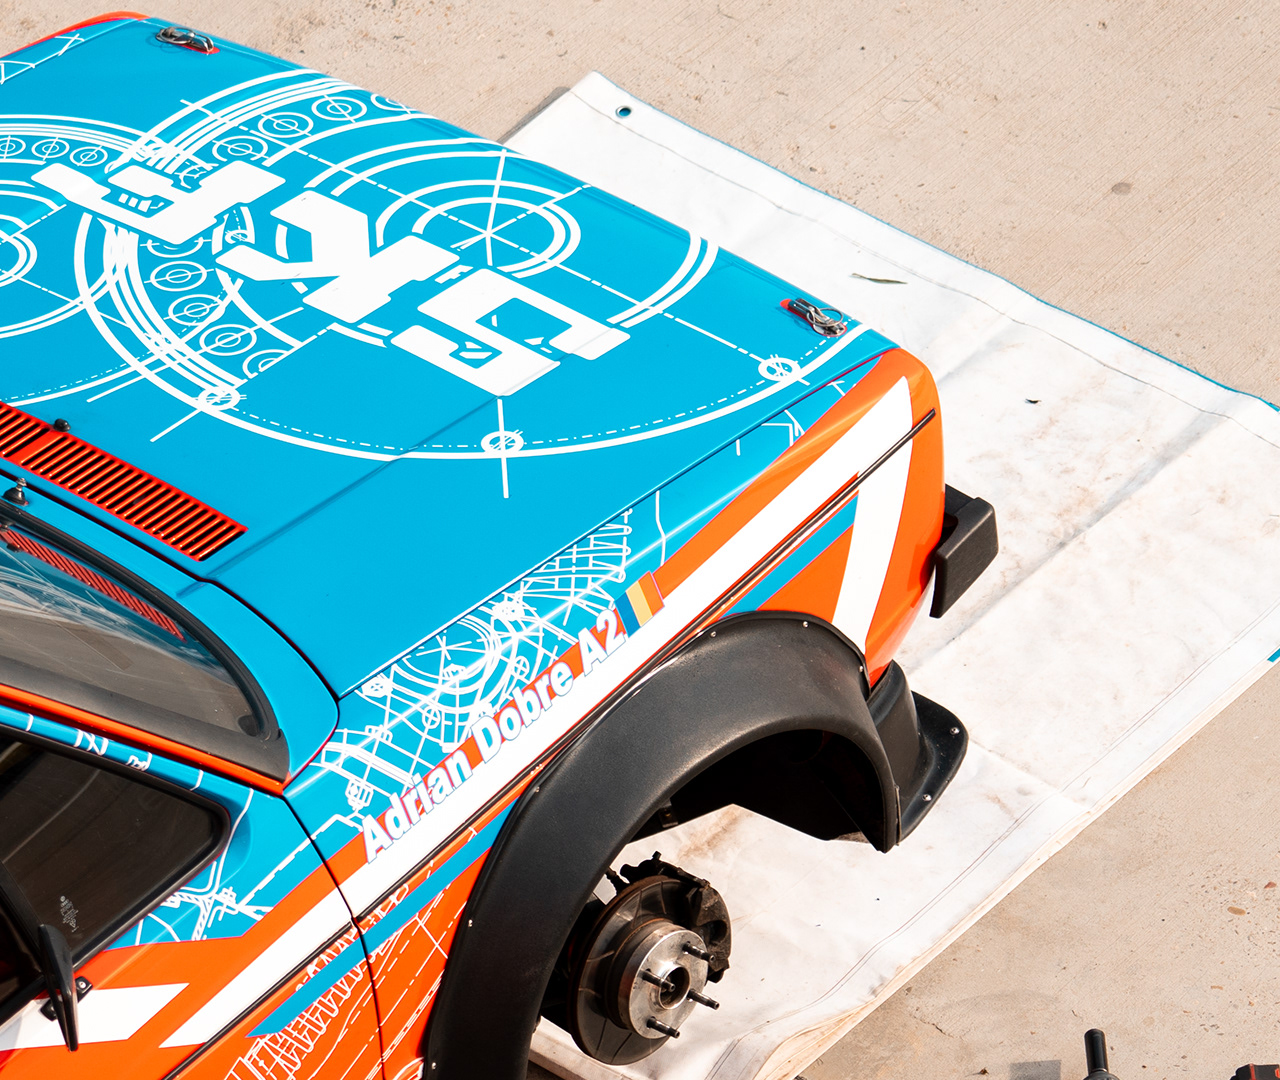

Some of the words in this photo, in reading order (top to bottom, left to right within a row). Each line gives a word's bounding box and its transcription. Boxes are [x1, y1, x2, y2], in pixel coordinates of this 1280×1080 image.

[30, 160, 632, 396] SKF
[361, 754, 473, 864] Adrian
[470, 660, 575, 764] Dobre
[577, 607, 627, 678] A2
